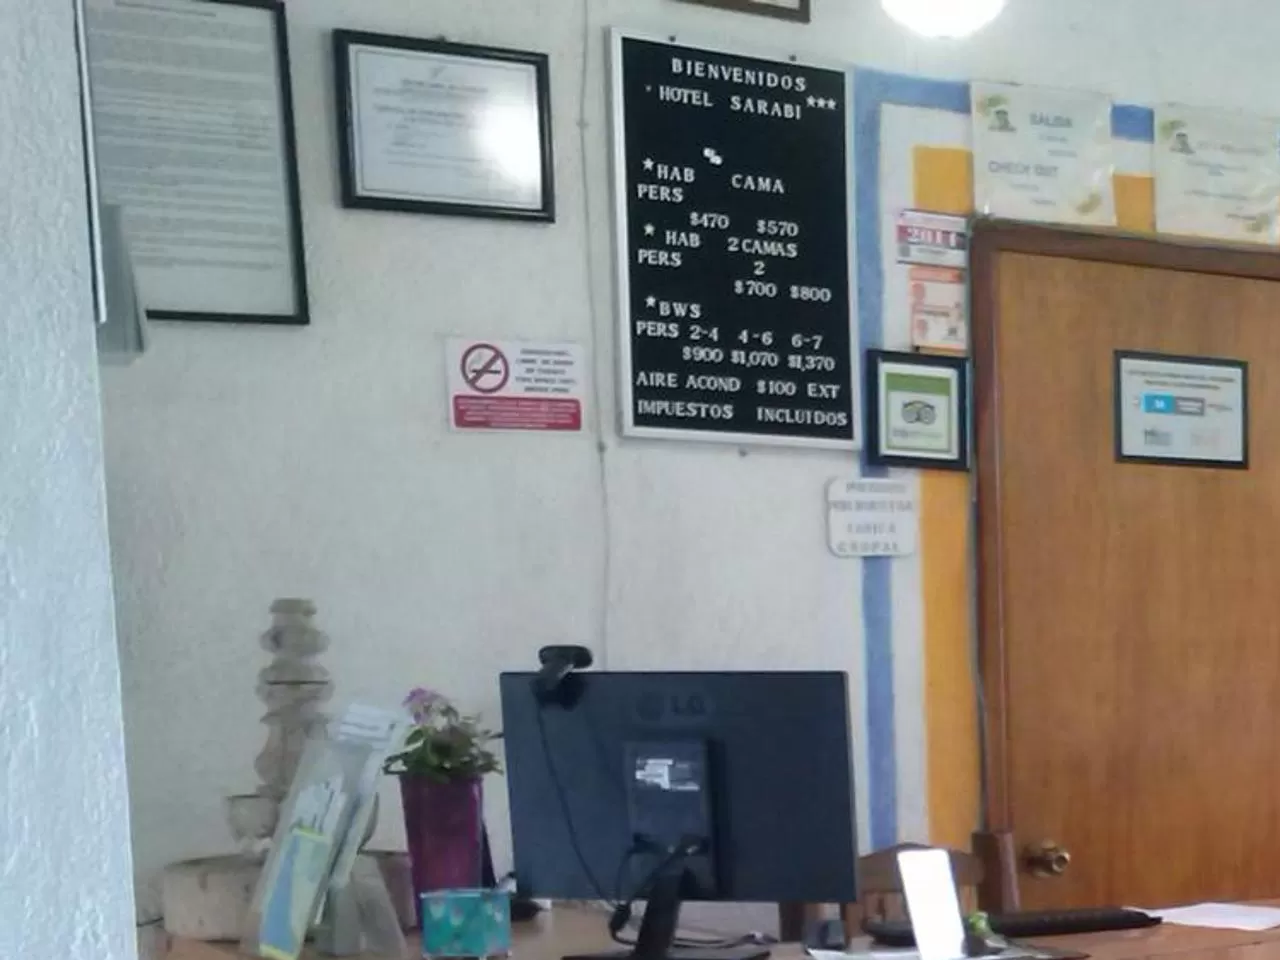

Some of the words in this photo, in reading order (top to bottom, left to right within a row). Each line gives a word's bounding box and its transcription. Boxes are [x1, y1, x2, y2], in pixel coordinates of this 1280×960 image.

[671, 57, 807, 92] BIENVENIDOS
[659, 85, 714, 108] HOTEL
[730, 95, 802, 120] SARABI
[657, 163, 696, 183] HAB
[731, 173, 785, 194] CAMA
[637, 184, 685, 203] PERS
[689, 211, 730, 230] $470
[756, 219, 799, 237] $570
[665, 230, 701, 248] HAB
[637, 248, 682, 267] PERS
[753, 260, 766, 276] 2
[734, 280, 777, 298] $700
[789, 284, 832, 302] $800
[659, 301, 702, 319] BWS
[636, 320, 680, 338] PERS
[689, 325, 719, 342] 2-4
[682, 345, 724, 363] $900
[636, 371, 679, 389] AIRE
[685, 375, 741, 392] ACOND
[756, 380, 797, 396] $100
[807, 383, 841, 400] EXT
[637, 399, 734, 420] IMPUESTOS
[757, 407, 848, 427] INCLUIDOS
